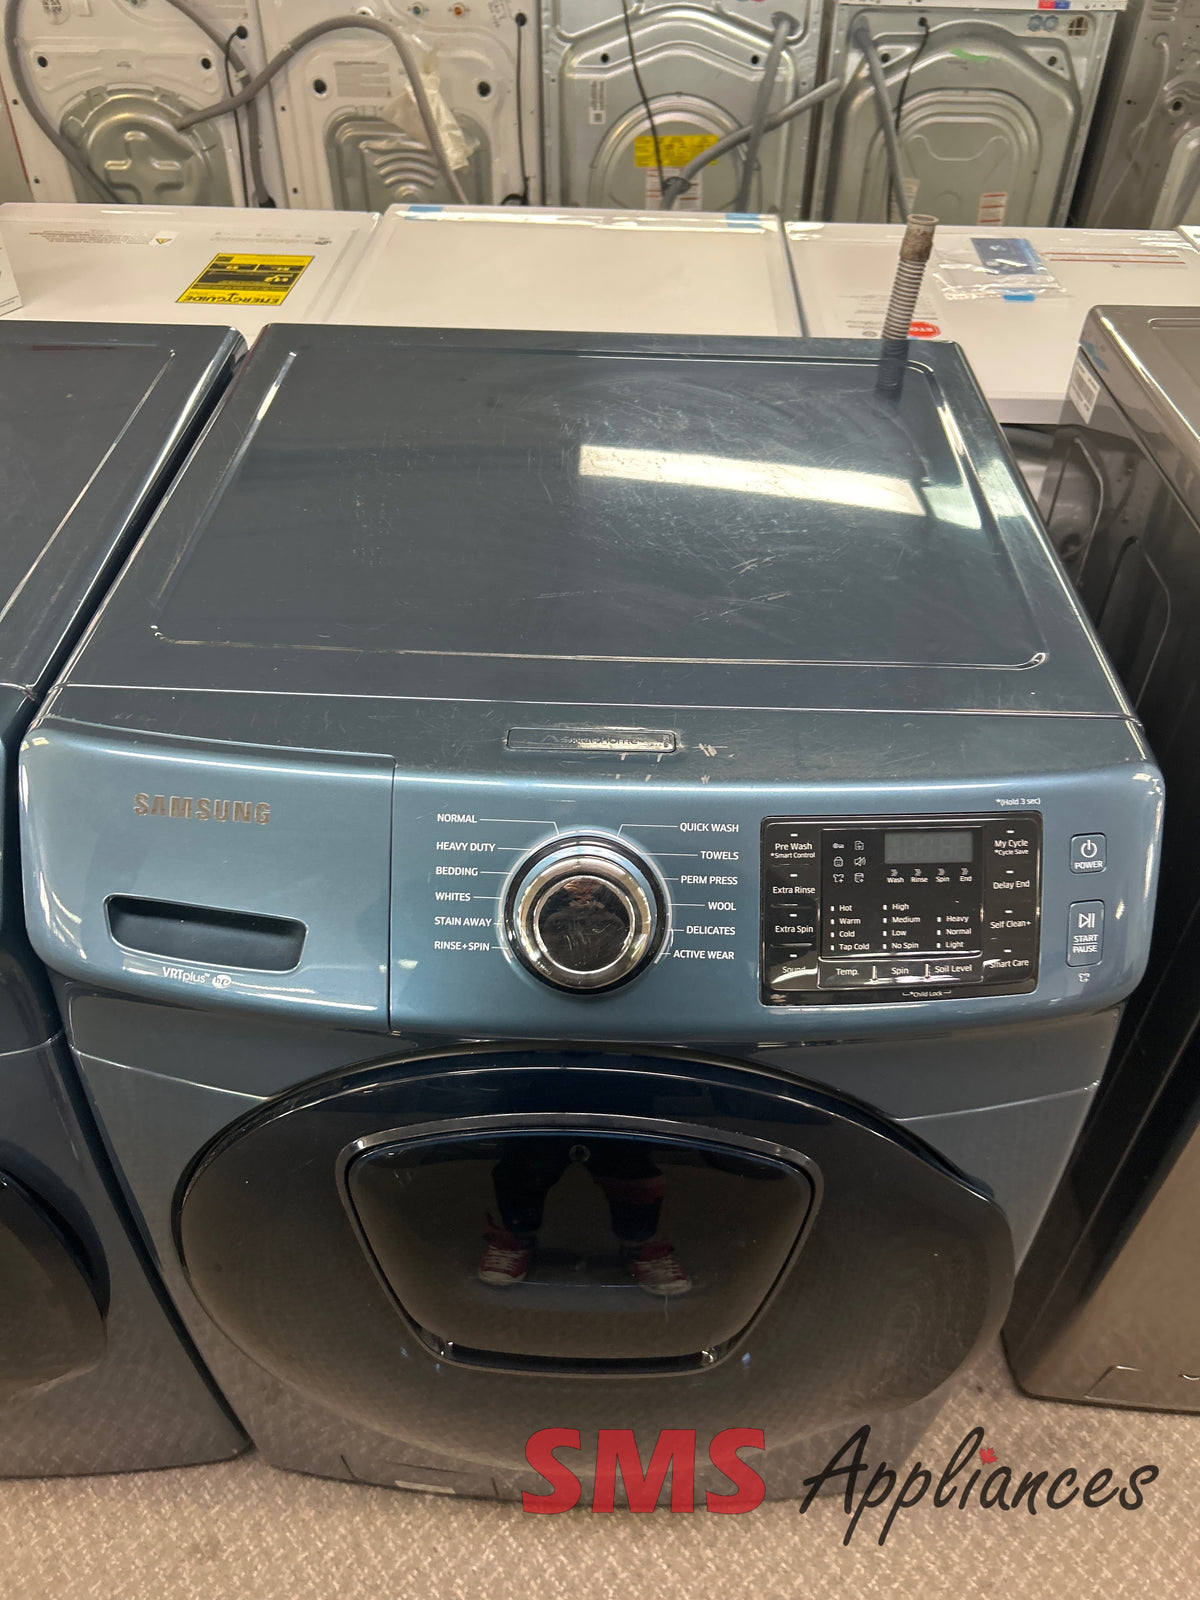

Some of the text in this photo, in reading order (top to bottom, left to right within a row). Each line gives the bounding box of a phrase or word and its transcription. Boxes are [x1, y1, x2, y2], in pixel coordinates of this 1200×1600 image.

[184, 294, 280, 304] ENERGYGUIDE
[1027, 797, 1041, 805] sec)
[133, 792, 272, 826] SAMSUNG
[437, 813, 478, 824] NORMAL
[680, 822, 740, 833] QUICK WASH
[436, 841, 496, 852] HEAVY DUTY
[774, 842, 813, 851] Pre Wash
[994, 839, 1029, 848] My Cycle
[700, 850, 740, 861] TOWELS
[1074, 860, 1103, 870] POWER
[435, 866, 479, 877] BEDDING
[680, 875, 739, 886] PERM PRESS
[886, 876, 905, 884] Wash
[935, 876, 950, 884] Spin
[992, 879, 1031, 891] Delay End
[772, 886, 816, 894] Extra Rinse
[434, 891, 471, 902] WHITES
[707, 901, 737, 911] WOOL
[839, 904, 853, 912] Hot
[892, 903, 910, 912] High
[434, 916, 493, 928] STAIN AWAY
[839, 917, 861, 925] Warm
[891, 915, 921, 923] Medium
[946, 915, 969, 924] Heavy
[774, 925, 814, 934] Extra Spin
[990, 919, 1032, 930] Self Clean+
[686, 925, 736, 936] DELICATES
[838, 930, 856, 938] Cold
[891, 929, 907, 937] Low
[945, 927, 972, 936] Normal
[1073, 933, 1099, 944] START
[434, 941, 490, 952] RINSE+SPIN
[839, 942, 870, 952] Tap Cold
[891, 941, 919, 950] No Spin
[945, 940, 964, 950] Light
[1072, 945, 1098, 955] PAUSE
[673, 949, 735, 960] ACTIVE WEAR
[935, 963, 973, 973] Soil Level
[1012, 959, 1030, 967] Care
[836, 967, 860, 976] Temp.
[891, 966, 909, 976] Spin
